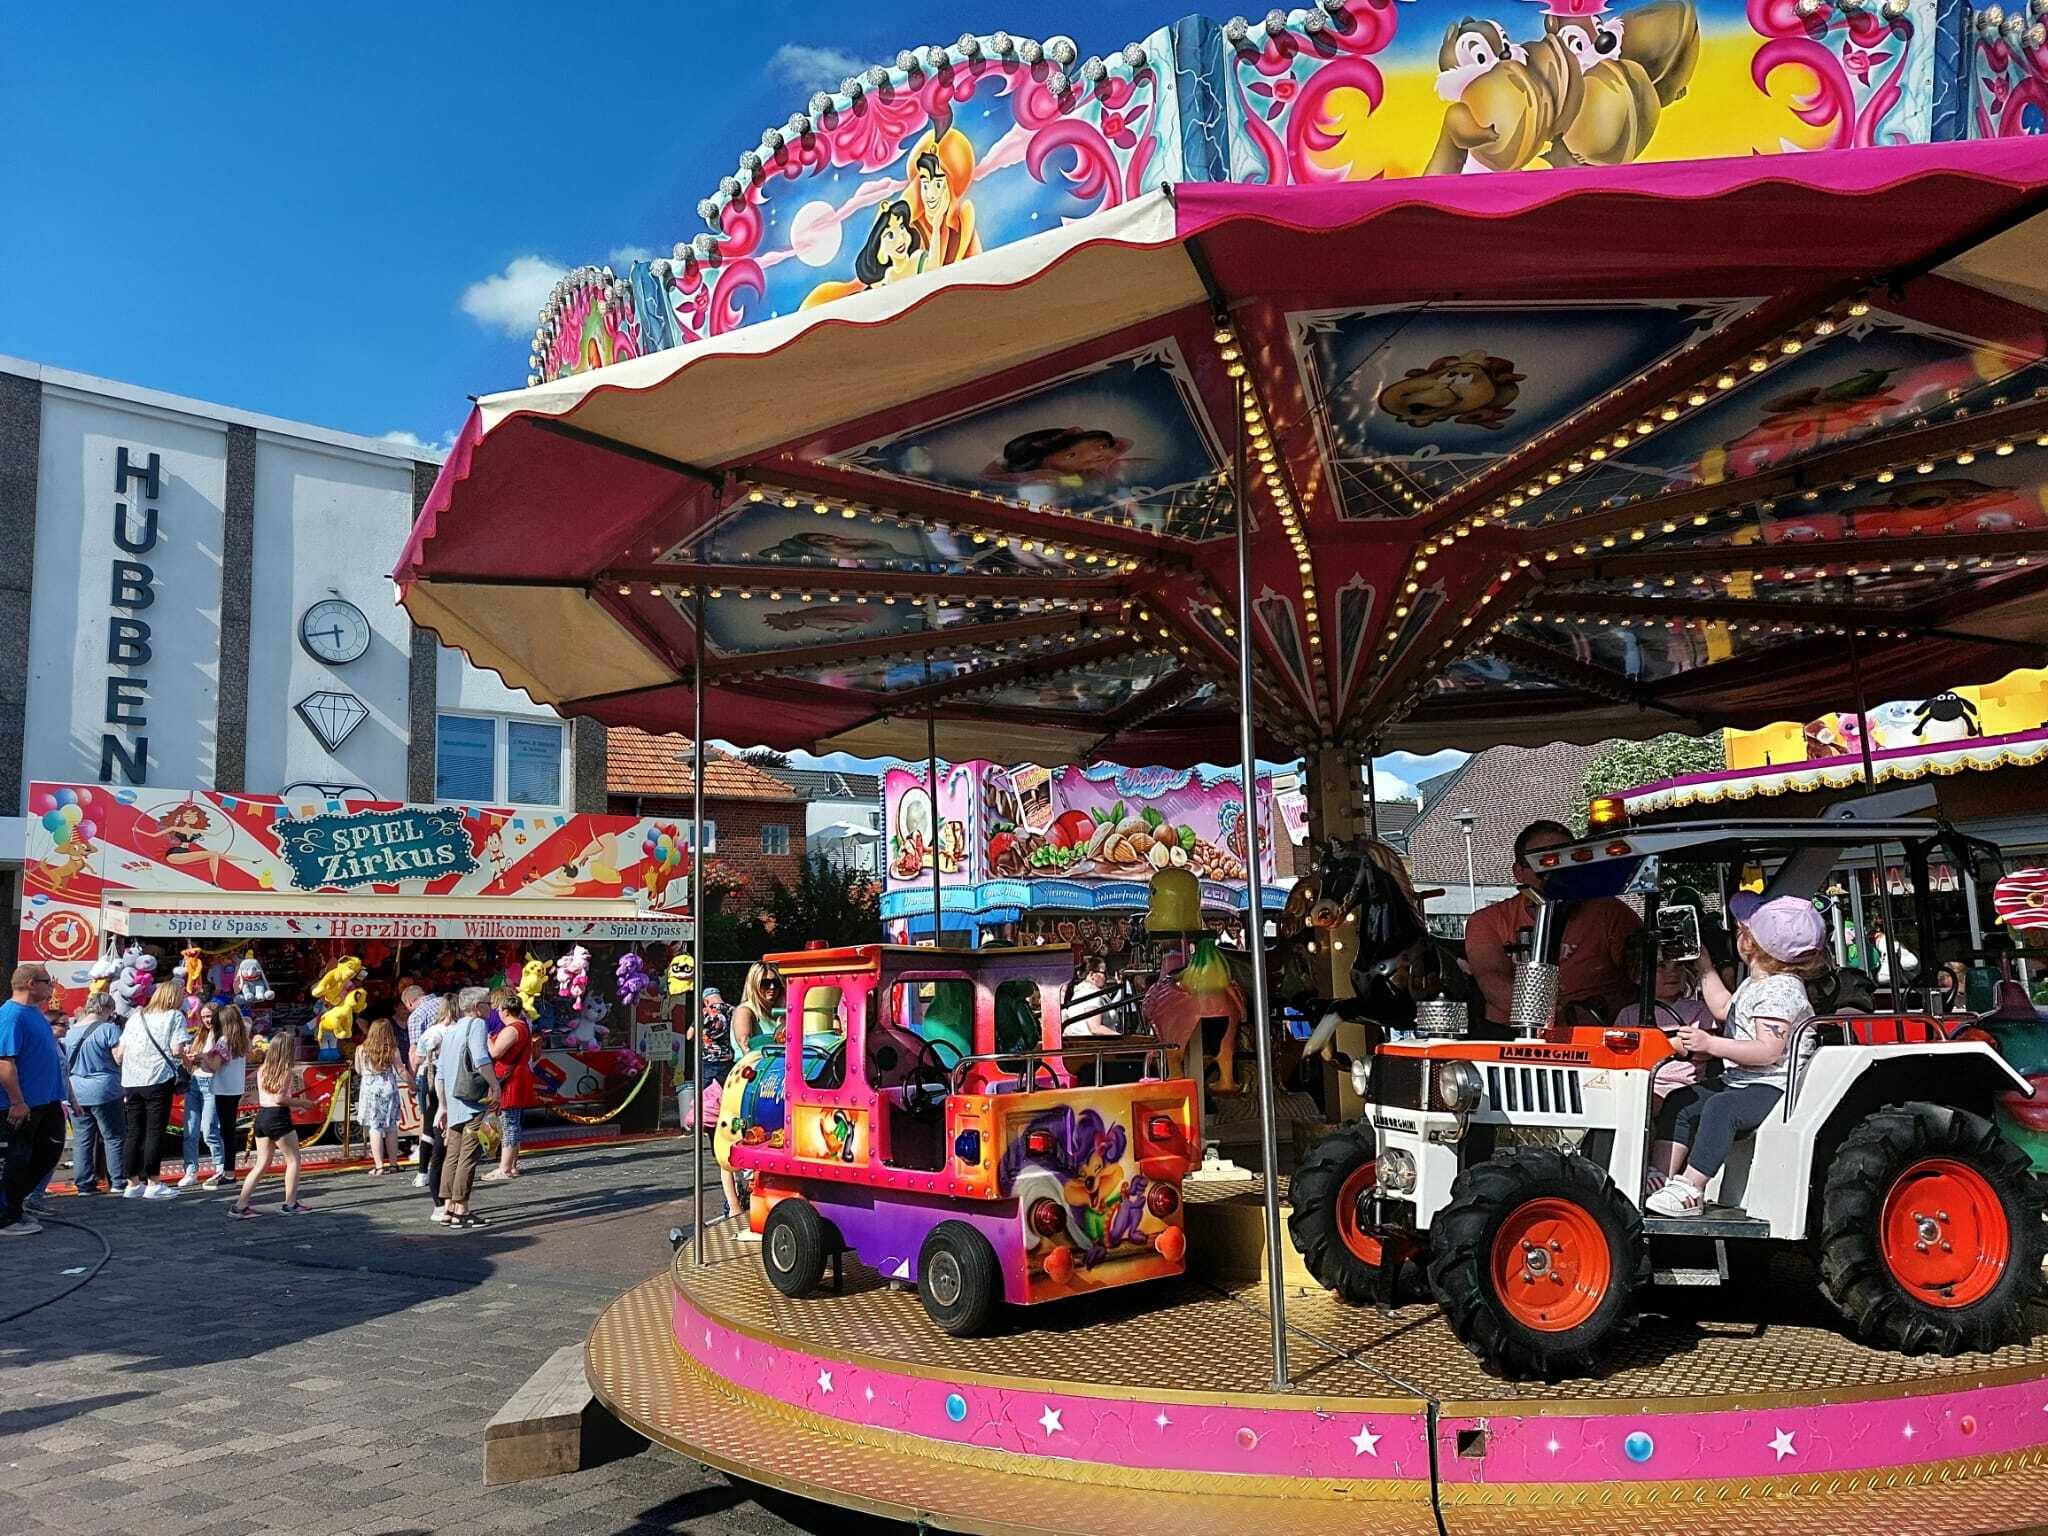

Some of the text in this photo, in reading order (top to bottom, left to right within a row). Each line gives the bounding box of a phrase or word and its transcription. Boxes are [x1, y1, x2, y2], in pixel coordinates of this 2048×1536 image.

[99, 446, 160, 785] HUBBEN
[332, 819, 424, 852] SPIEL
[317, 844, 456, 882] Zirkus
[168, 918, 268, 934] Spiel & Spass
[329, 919, 561, 938] Herzlich Willkommen
[610, 924, 681, 937] Spiel & Spass
[1499, 1047, 1591, 1064] LAMBORGHINI
